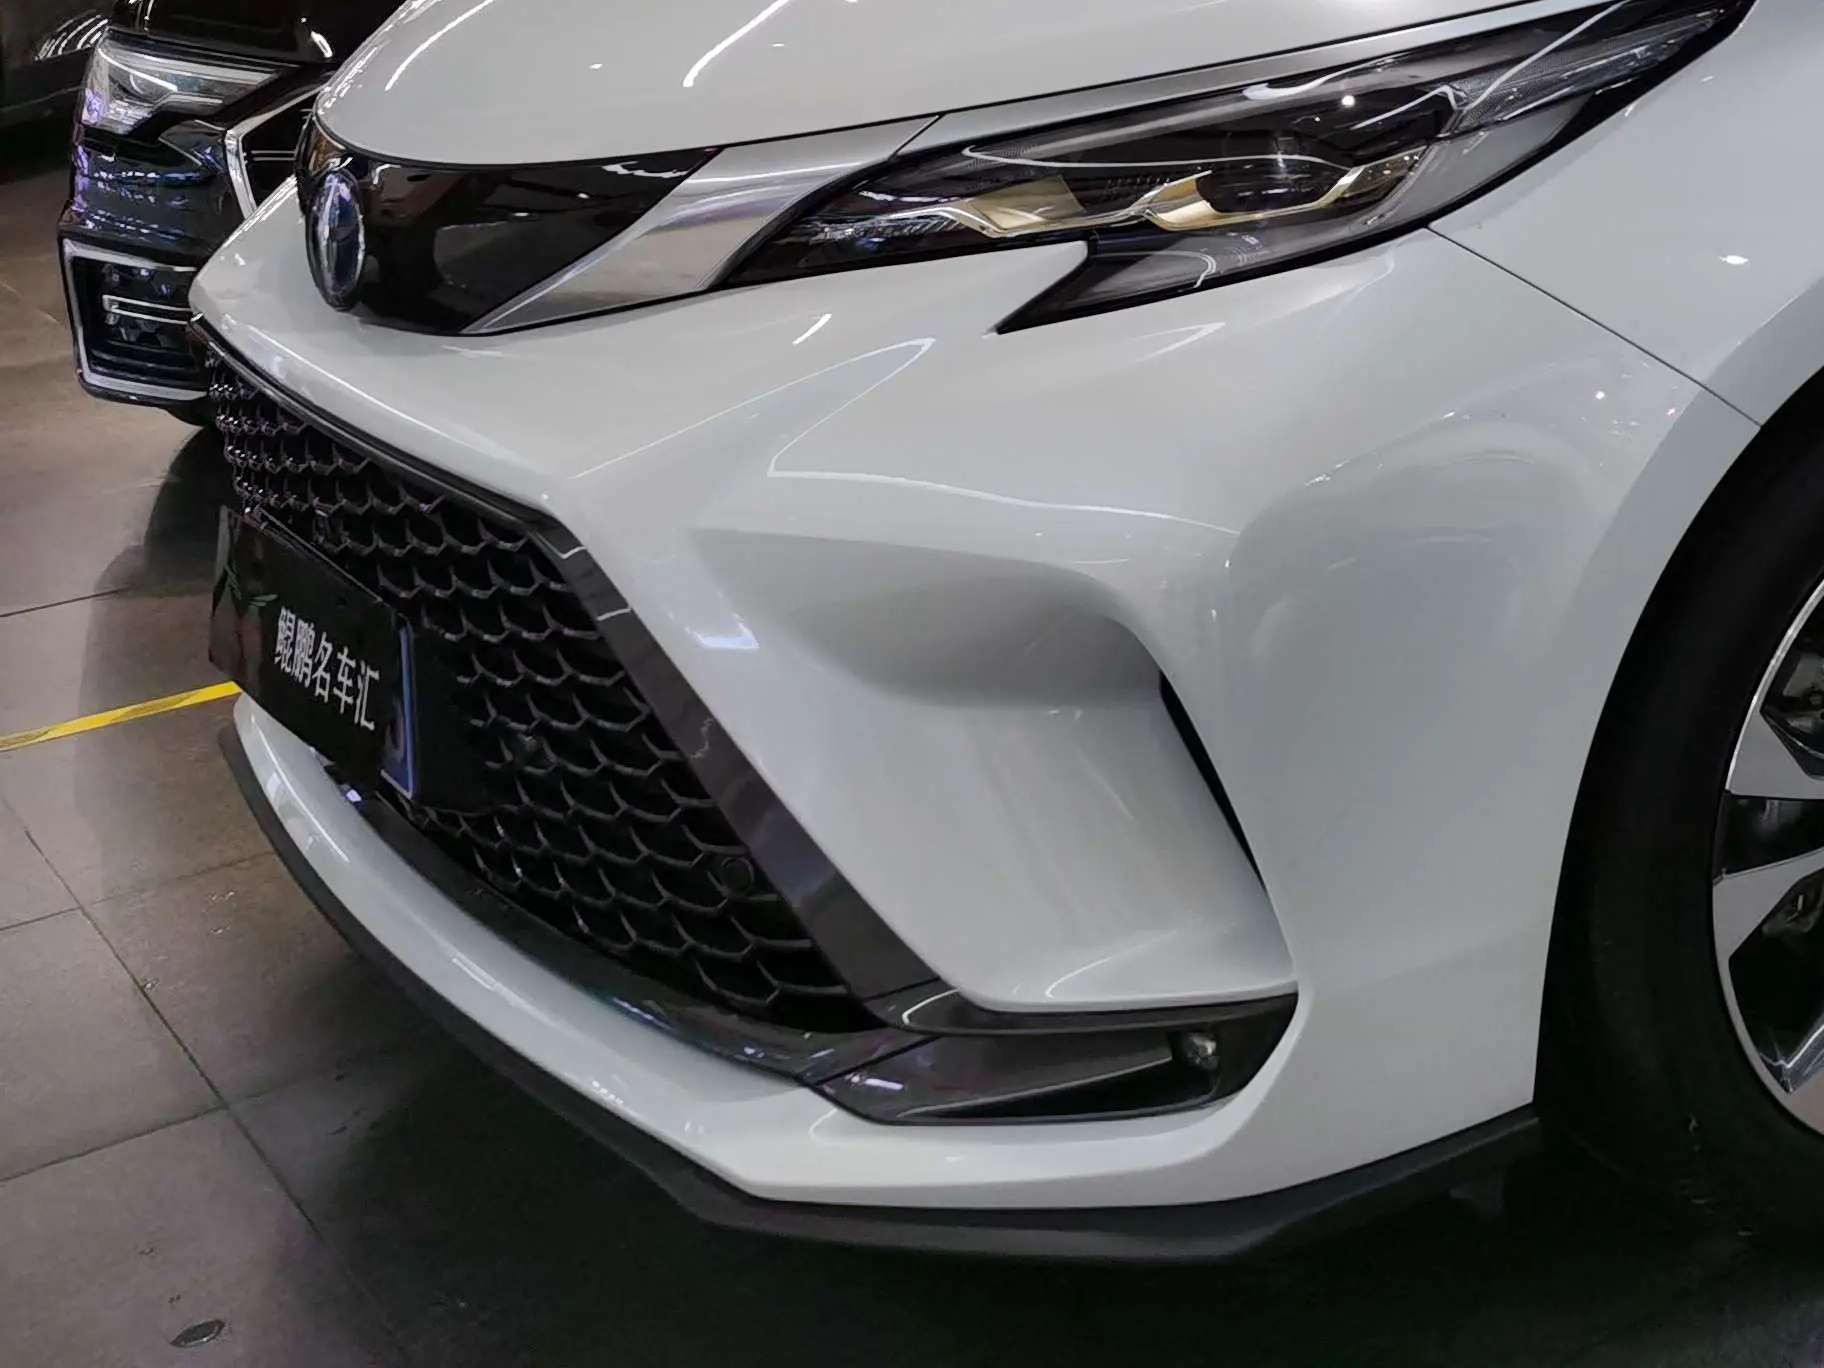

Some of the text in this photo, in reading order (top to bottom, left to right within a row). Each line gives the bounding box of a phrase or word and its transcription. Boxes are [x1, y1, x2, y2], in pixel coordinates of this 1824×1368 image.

[274, 606, 380, 731] 鲲鹏名车汇
